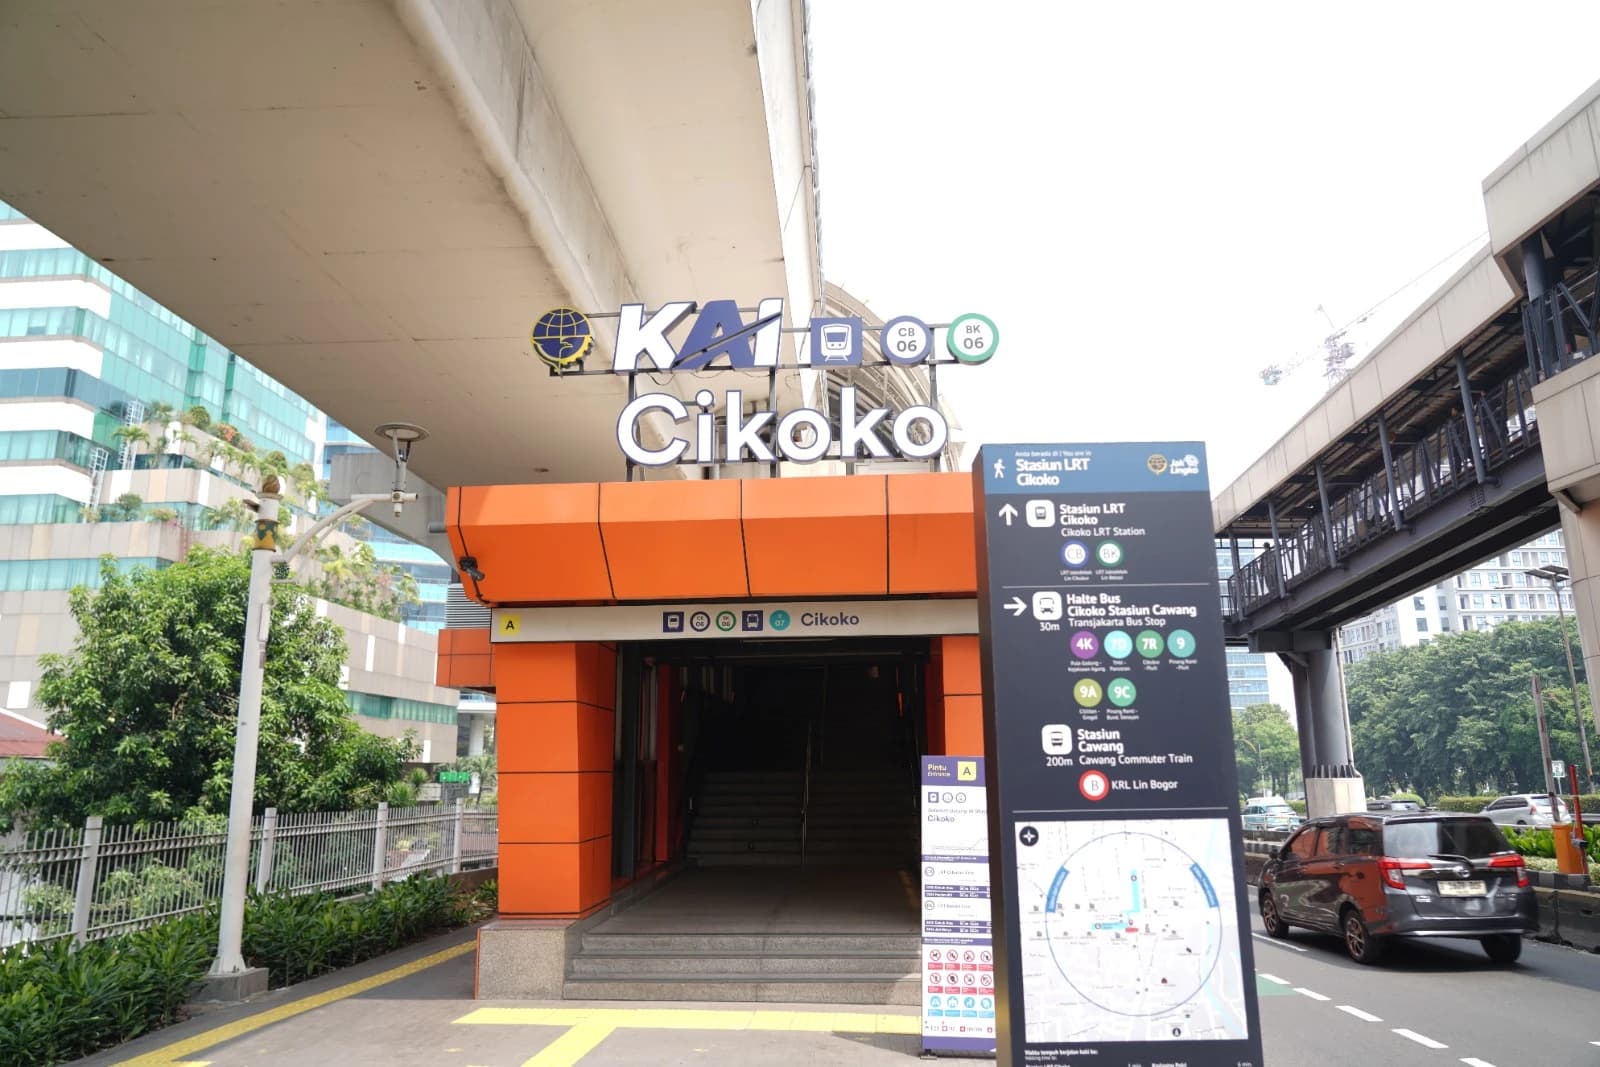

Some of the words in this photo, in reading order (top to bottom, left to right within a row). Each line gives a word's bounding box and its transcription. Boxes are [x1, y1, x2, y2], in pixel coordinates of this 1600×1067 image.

[612, 297, 784, 374] KAI
[898, 327, 916, 337] CB
[966, 325, 981, 334] BK
[896, 340, 918, 352] 06
[964, 337, 984, 350] 06
[616, 384, 948, 468] Cikoko
[1016, 458, 1062, 471] Stasiun
[1064, 458, 1090, 470] LRT
[1016, 473, 1060, 486] Cikoko
[1060, 504, 1100, 514] Stasiun
[1103, 503, 1126, 514] LRT
[1060, 514, 1098, 525] Cikoko
[1061, 528, 1091, 537] Cikoko
[1094, 528, 1111, 536] LRT
[1113, 527, 1146, 536] Station
[1066, 548, 1082, 560] CB
[1103, 548, 1118, 559] BK
[1067, 594, 1097, 604] Halte
[1100, 594, 1120, 604] Bus
[1067, 606, 1106, 616] Cikoko
[1108, 604, 1150, 616] Stasiun
[1152, 604, 1197, 618] Cawang
[506, 620, 515, 630] A
[801, 612, 860, 626] Cikoko
[1068, 618, 1124, 628] Transjakarta
[1126, 617, 1142, 626] Bus
[1144, 616, 1166, 628] Stop
[1040, 622, 1060, 631] 30m
[1076, 638, 1094, 650] 4K
[1142, 638, 1158, 650] 7R
[1176, 637, 1185, 649] 9
[1080, 686, 1097, 698] 9A
[1114, 686, 1131, 698] 9C
[1077, 728, 1120, 740] Stasiun
[1078, 741, 1124, 754] Cawang
[1046, 757, 1073, 766] 200m
[1079, 756, 1116, 766] Cawang
[1118, 754, 1166, 765] Commuter
[1168, 753, 1193, 763] Train
[963, 767, 971, 776] A
[1091, 780, 1100, 791] B
[1112, 780, 1130, 790] KRL
[1133, 780, 1148, 789] Lin
[1150, 780, 1178, 791] Bogor
